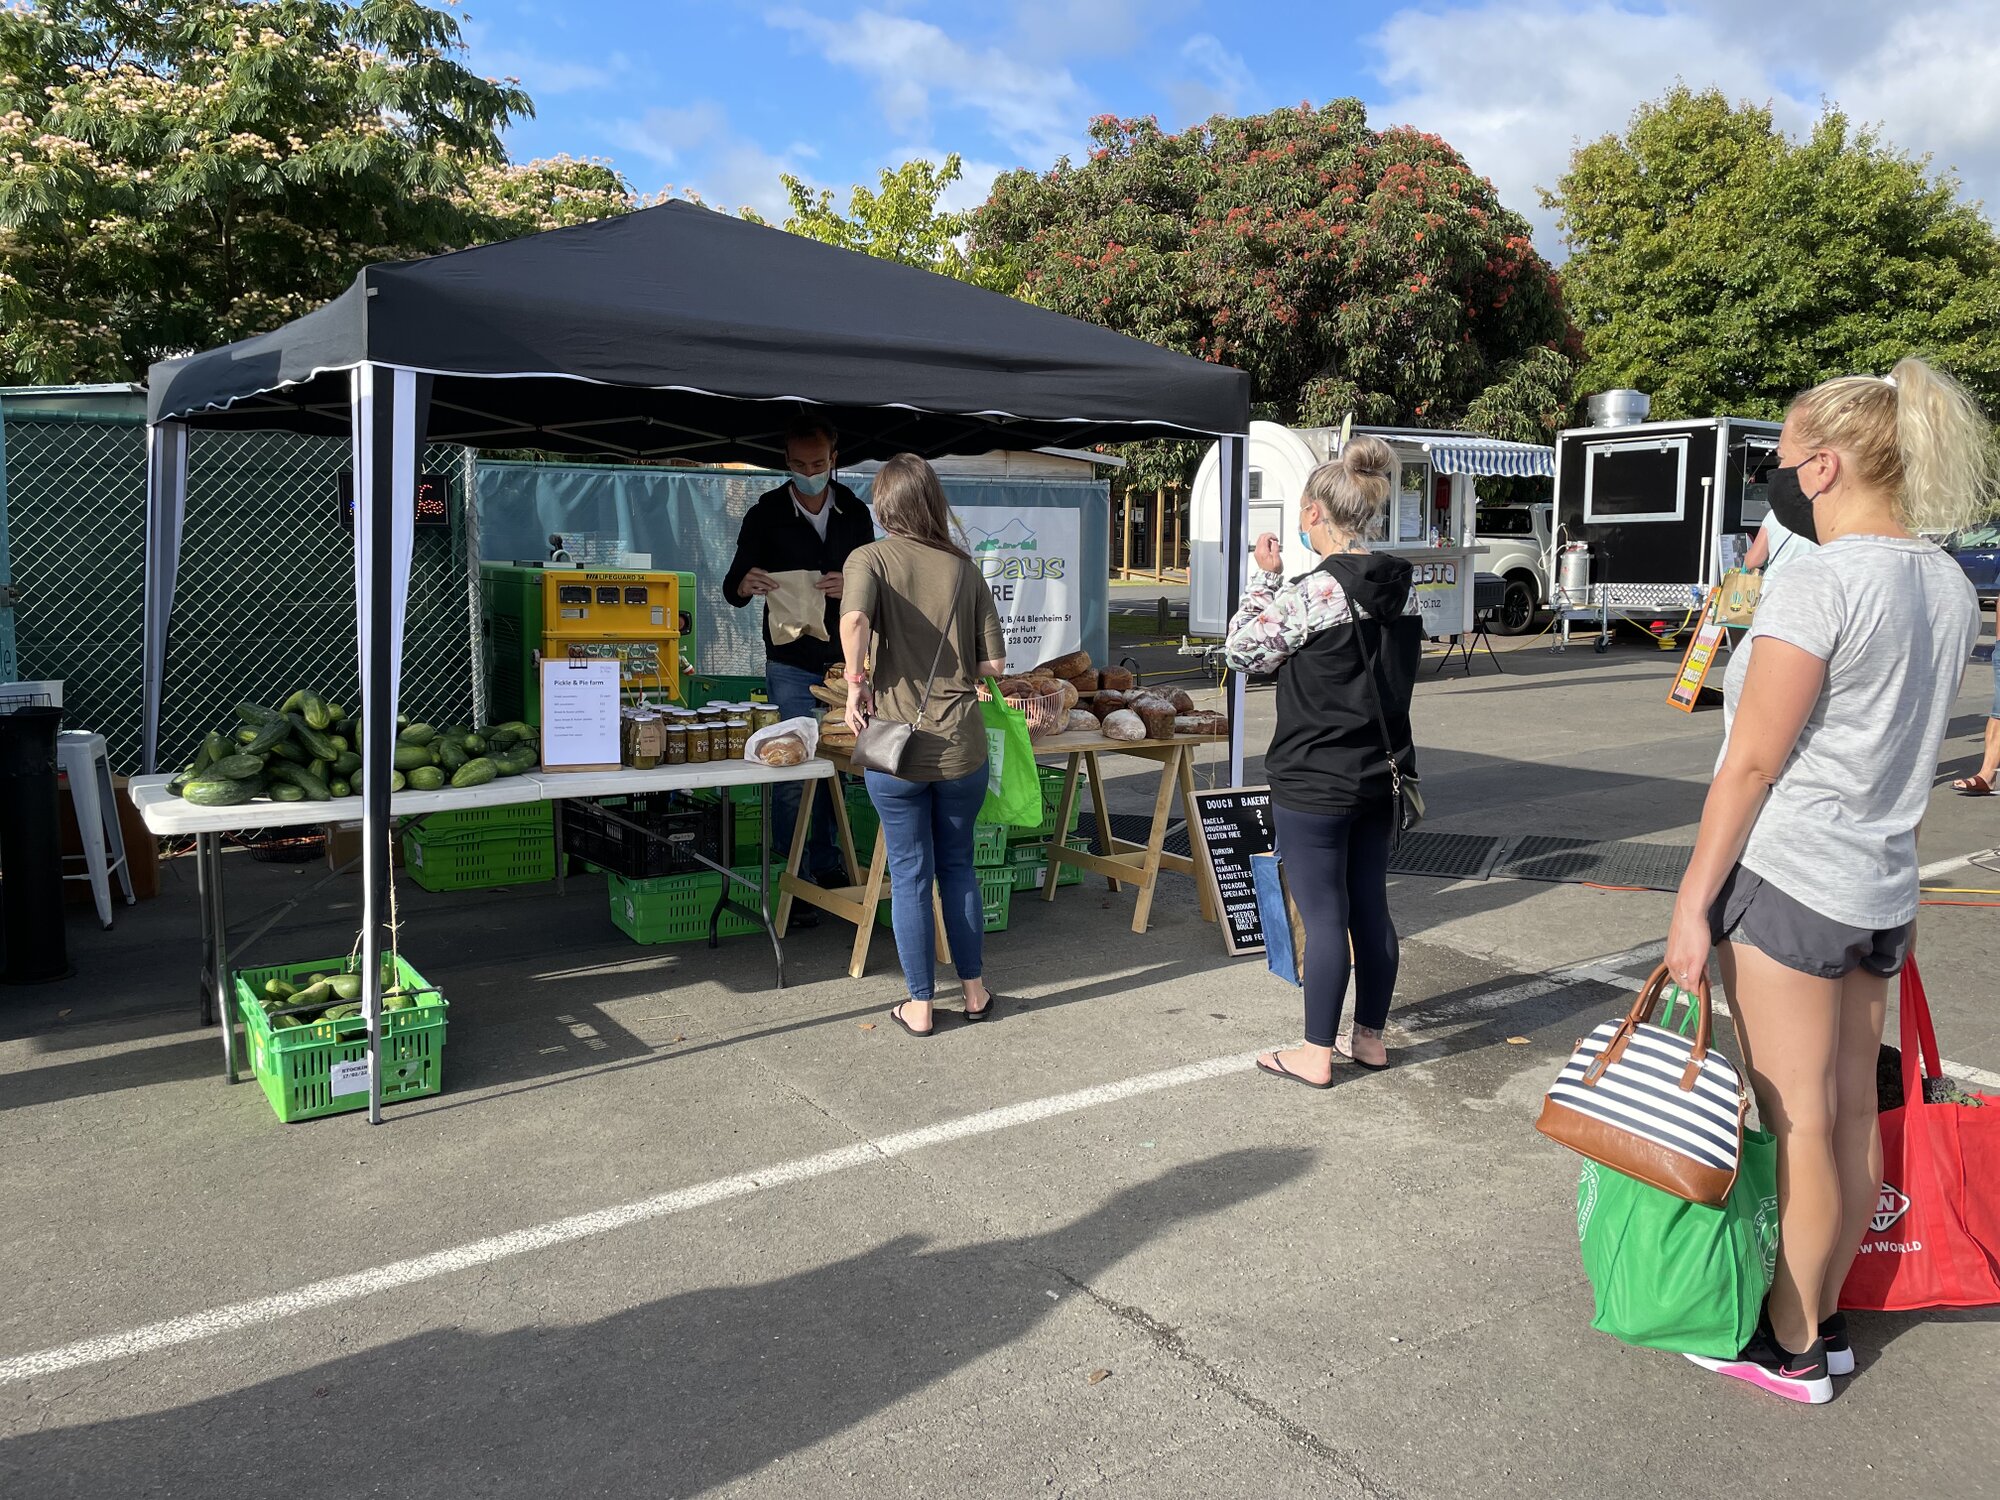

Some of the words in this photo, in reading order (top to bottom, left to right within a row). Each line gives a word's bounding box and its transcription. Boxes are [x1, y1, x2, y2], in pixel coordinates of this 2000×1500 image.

[974, 556, 1066, 580] Days
[1411, 563, 1455, 585] asta
[1007, 615, 1026, 624] B/44
[1027, 615, 1063, 623] Blenheim
[1064, 614, 1072, 622] St
[1000, 625, 1019, 635] pper
[1020, 625, 1037, 634] Hutt
[1008, 636, 1022, 645] 528
[1023, 635, 1042, 644] 0077
[1206, 798, 1233, 810] DOUGH
[1240, 795, 1270, 807] BAKERY
[1202, 816, 1225, 825] BAGELS
[1255, 809, 1262, 819] 2
[1204, 823, 1238, 833] DOUGHNUTS
[1228, 831, 1241, 839] FREE
[1261, 828, 1268, 836] 10
[1211, 847, 1234, 856] TURKISH
[1214, 857, 1226, 865] RYE
[1215, 864, 1242, 873] CIABATTA
[1217, 870, 1253, 881] BAGUETTES
[1220, 881, 1247, 890] FOCACCIA
[1222, 889, 1251, 898] SPECIALTY
[1226, 902, 1257, 912] SOURDOUGH
[1232, 910, 1255, 919] SEEDED
[1874, 1240, 1923, 1254] WORLD
